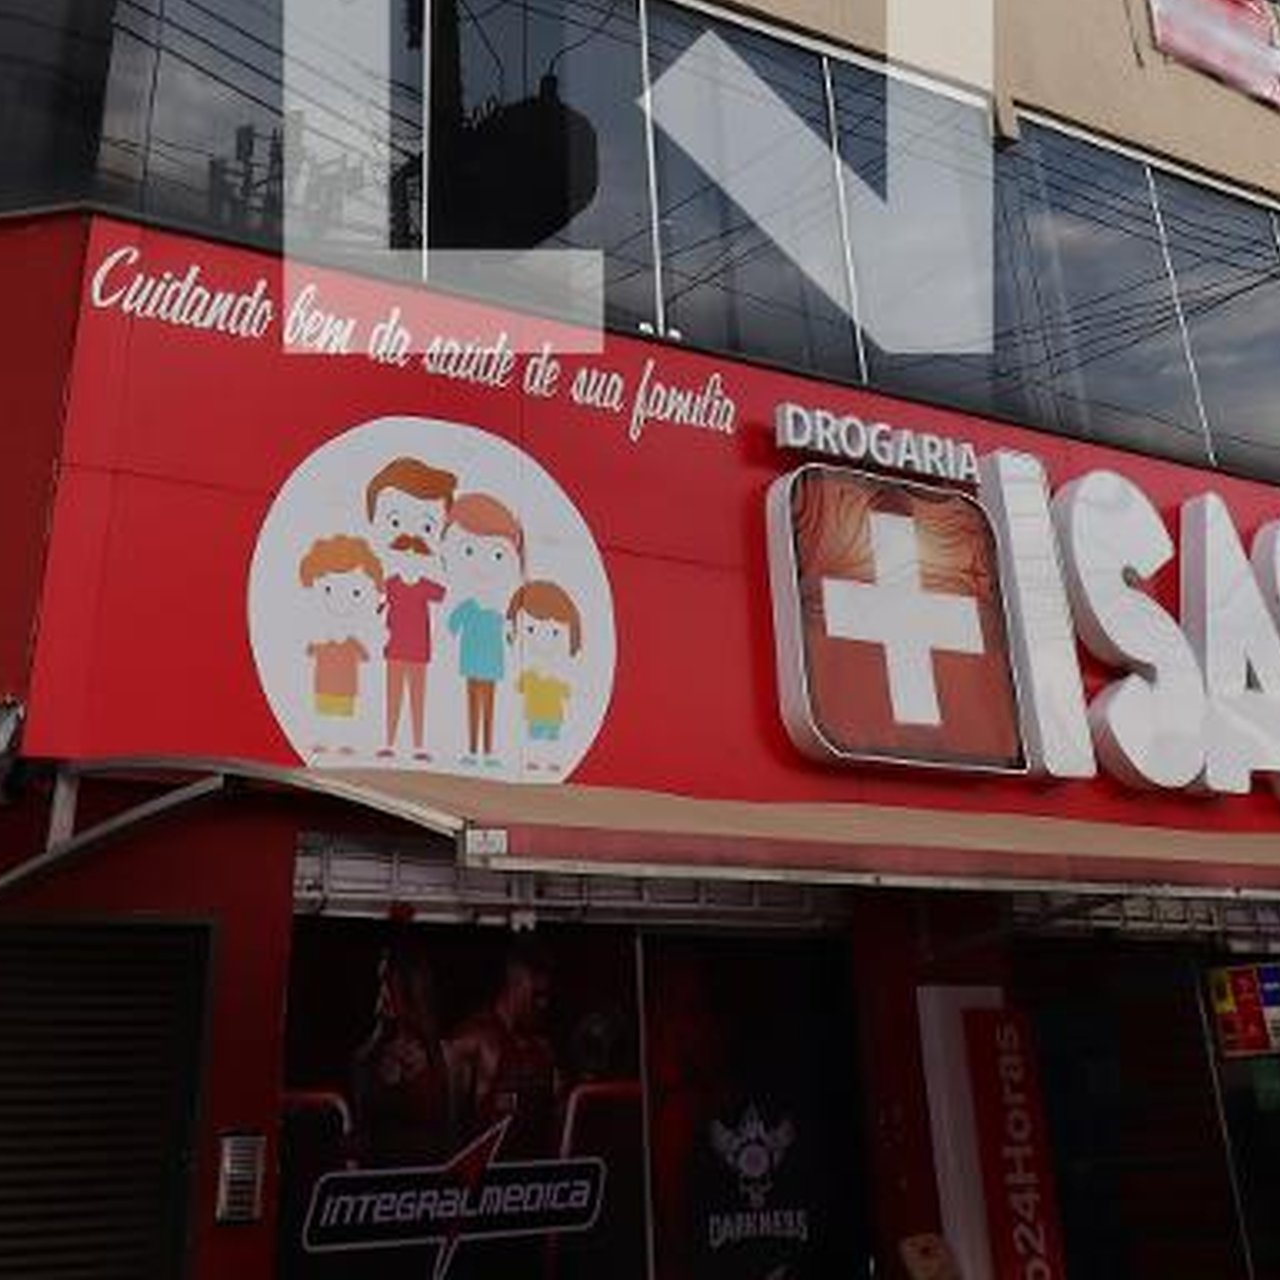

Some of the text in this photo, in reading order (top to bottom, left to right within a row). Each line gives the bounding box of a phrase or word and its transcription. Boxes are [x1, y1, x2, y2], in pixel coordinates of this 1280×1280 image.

[91, 245, 275, 338] Cuidando
[283, 283, 356, 356] bem
[370, 306, 412, 368] da
[523, 341, 561, 398] de
[570, 366, 626, 414] sua
[776, 402, 981, 484] DROGARIA
